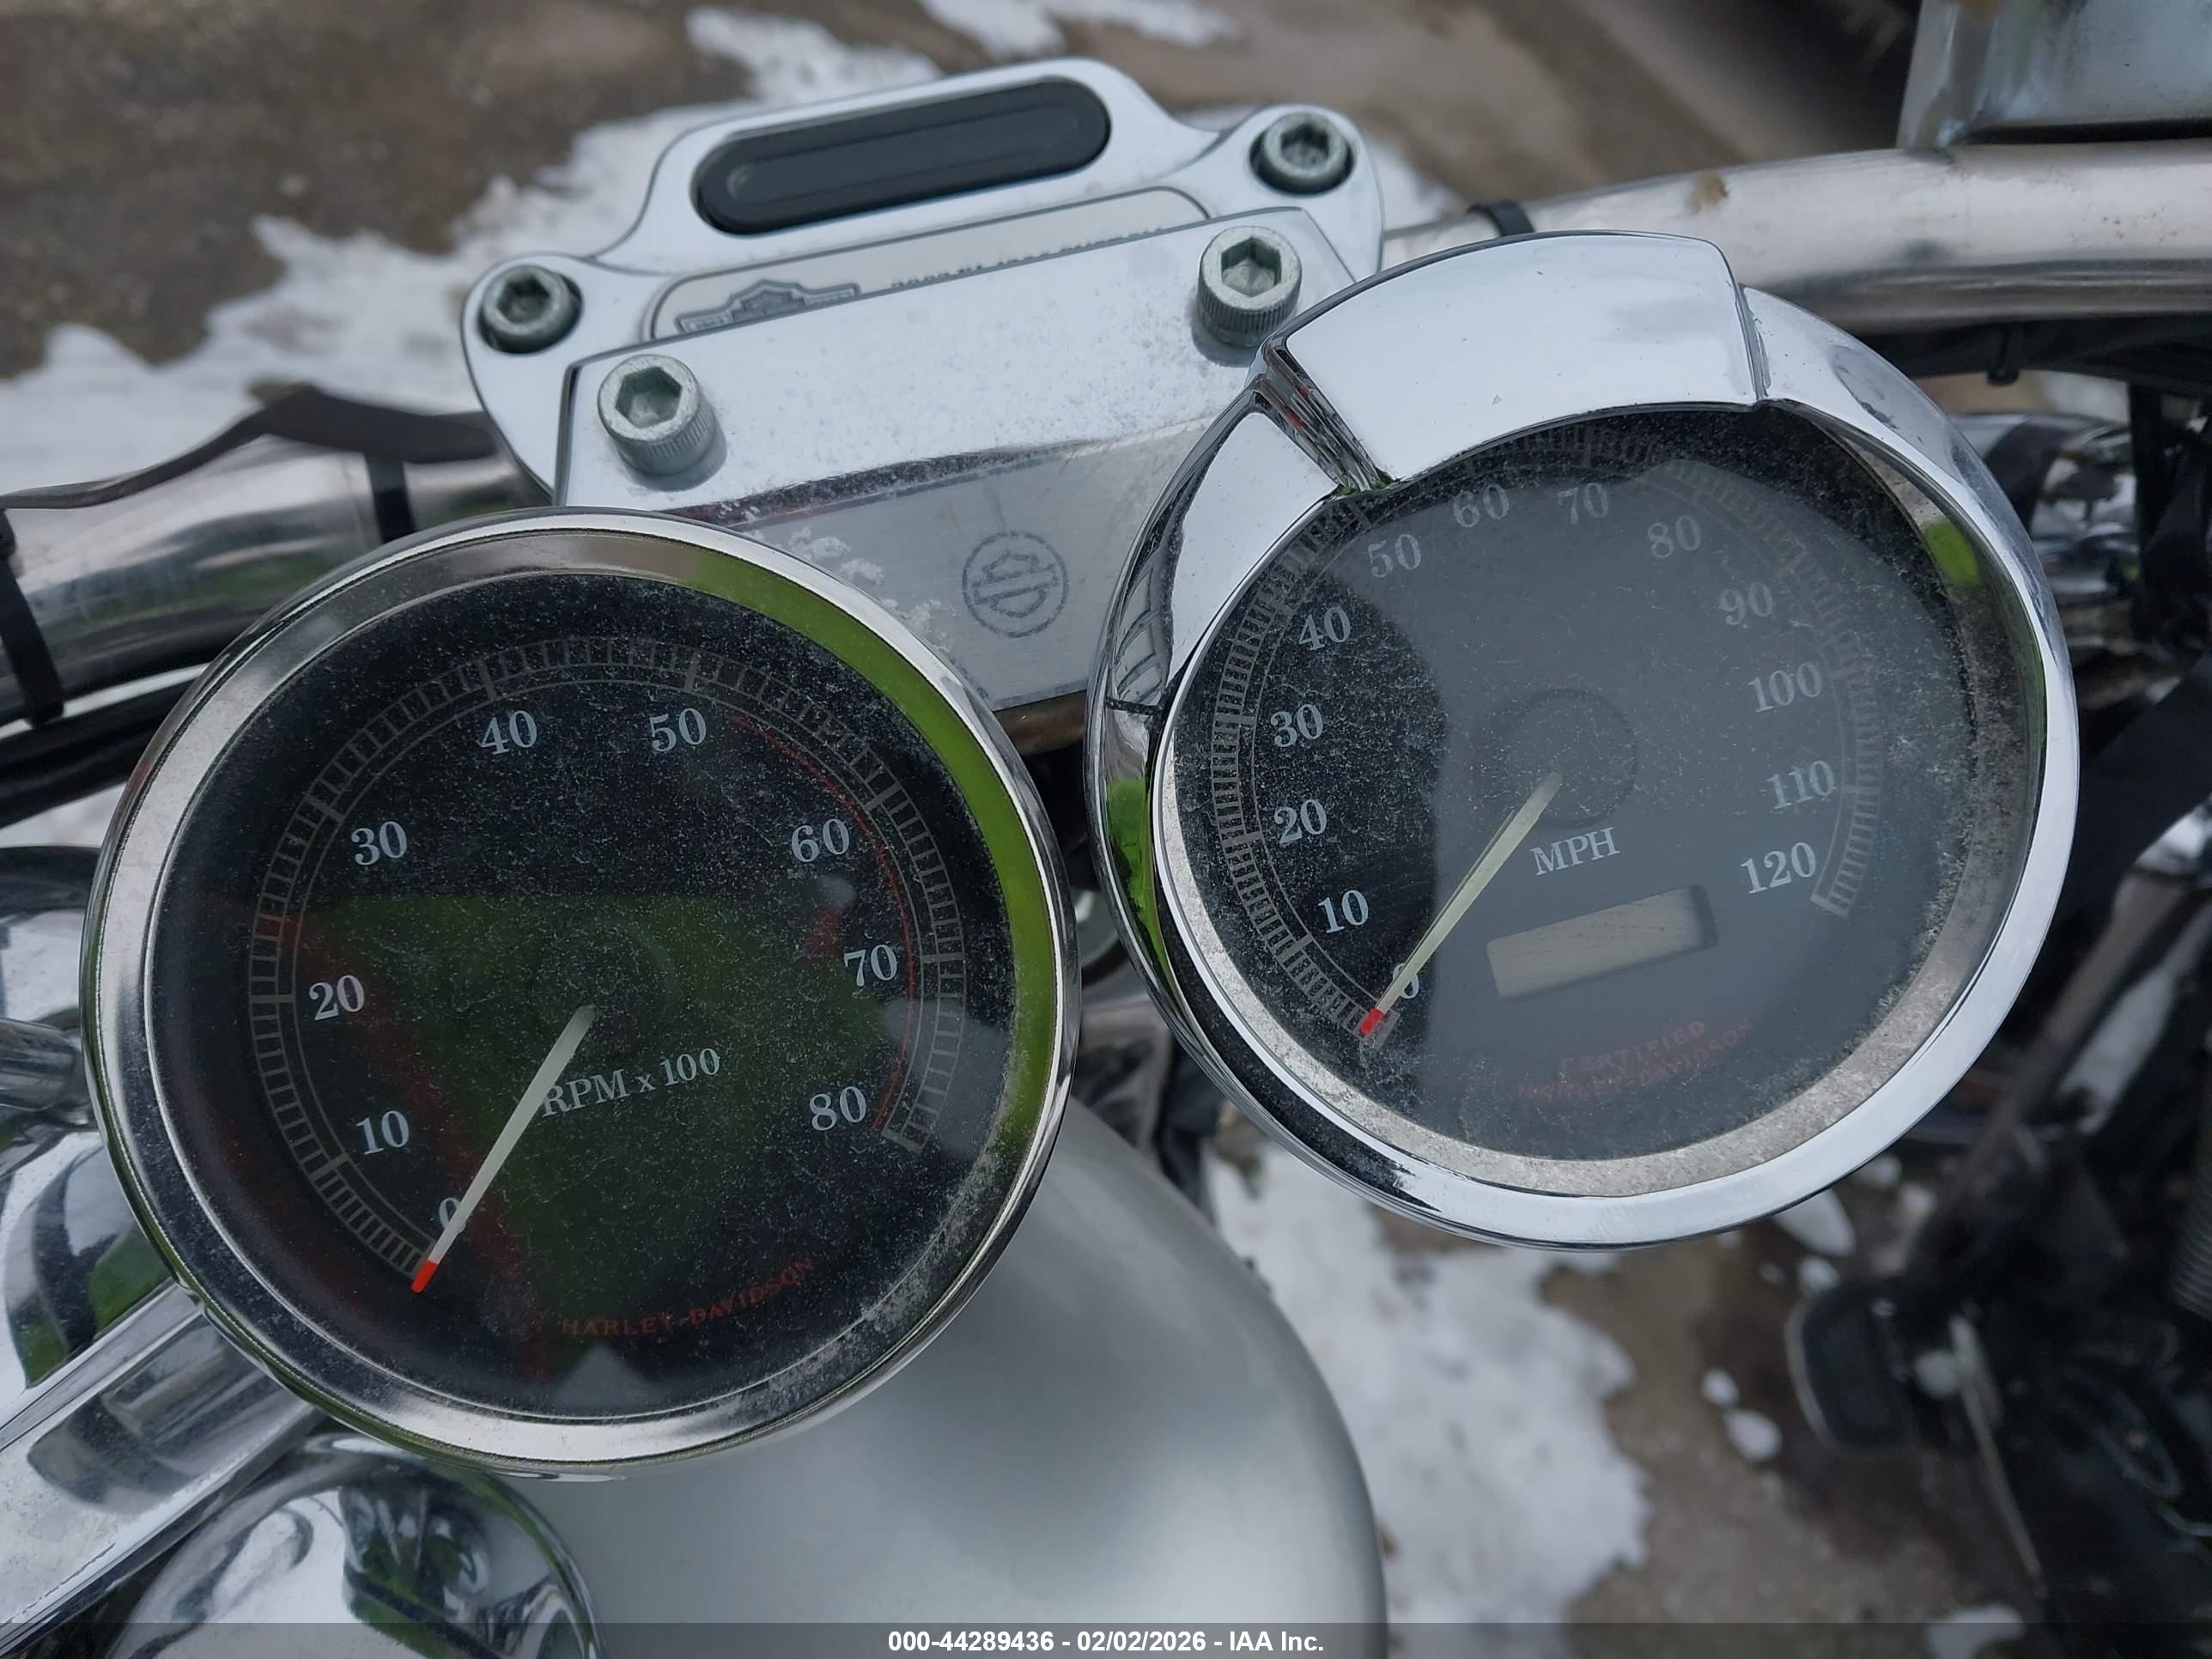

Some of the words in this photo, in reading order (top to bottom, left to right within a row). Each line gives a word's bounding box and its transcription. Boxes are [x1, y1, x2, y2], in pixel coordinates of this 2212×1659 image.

[1452, 483, 1510, 528] 60
[1557, 482, 1610, 525] 70
[1367, 532, 1423, 578] 50
[1646, 515, 1702, 559] 80
[1719, 581, 1773, 626] 90
[1297, 606, 1352, 652] 40
[1747, 661, 1822, 714] 100
[479, 709, 538, 756] 40
[648, 708, 707, 752] 50
[1270, 703, 1324, 748] 30
[1766, 760, 1836, 810] 110
[350, 821, 408, 866] 30
[791, 817, 850, 863] 60
[1273, 799, 1328, 845] 20
[1528, 827, 1620, 876] MPH
[1740, 842, 1817, 894] 120
[1317, 890, 1370, 933] 10
[843, 944, 897, 988] 70
[309, 975, 365, 1021] 20
[542, 1068, 631, 1117] RPM
[635, 1073, 656, 1093] x
[659, 1048, 721, 1086] 100
[809, 1085, 866, 1131] 80
[356, 1109, 410, 1156] 10
[562, 1257, 813, 1334] HARLEY-DAVIDSON
